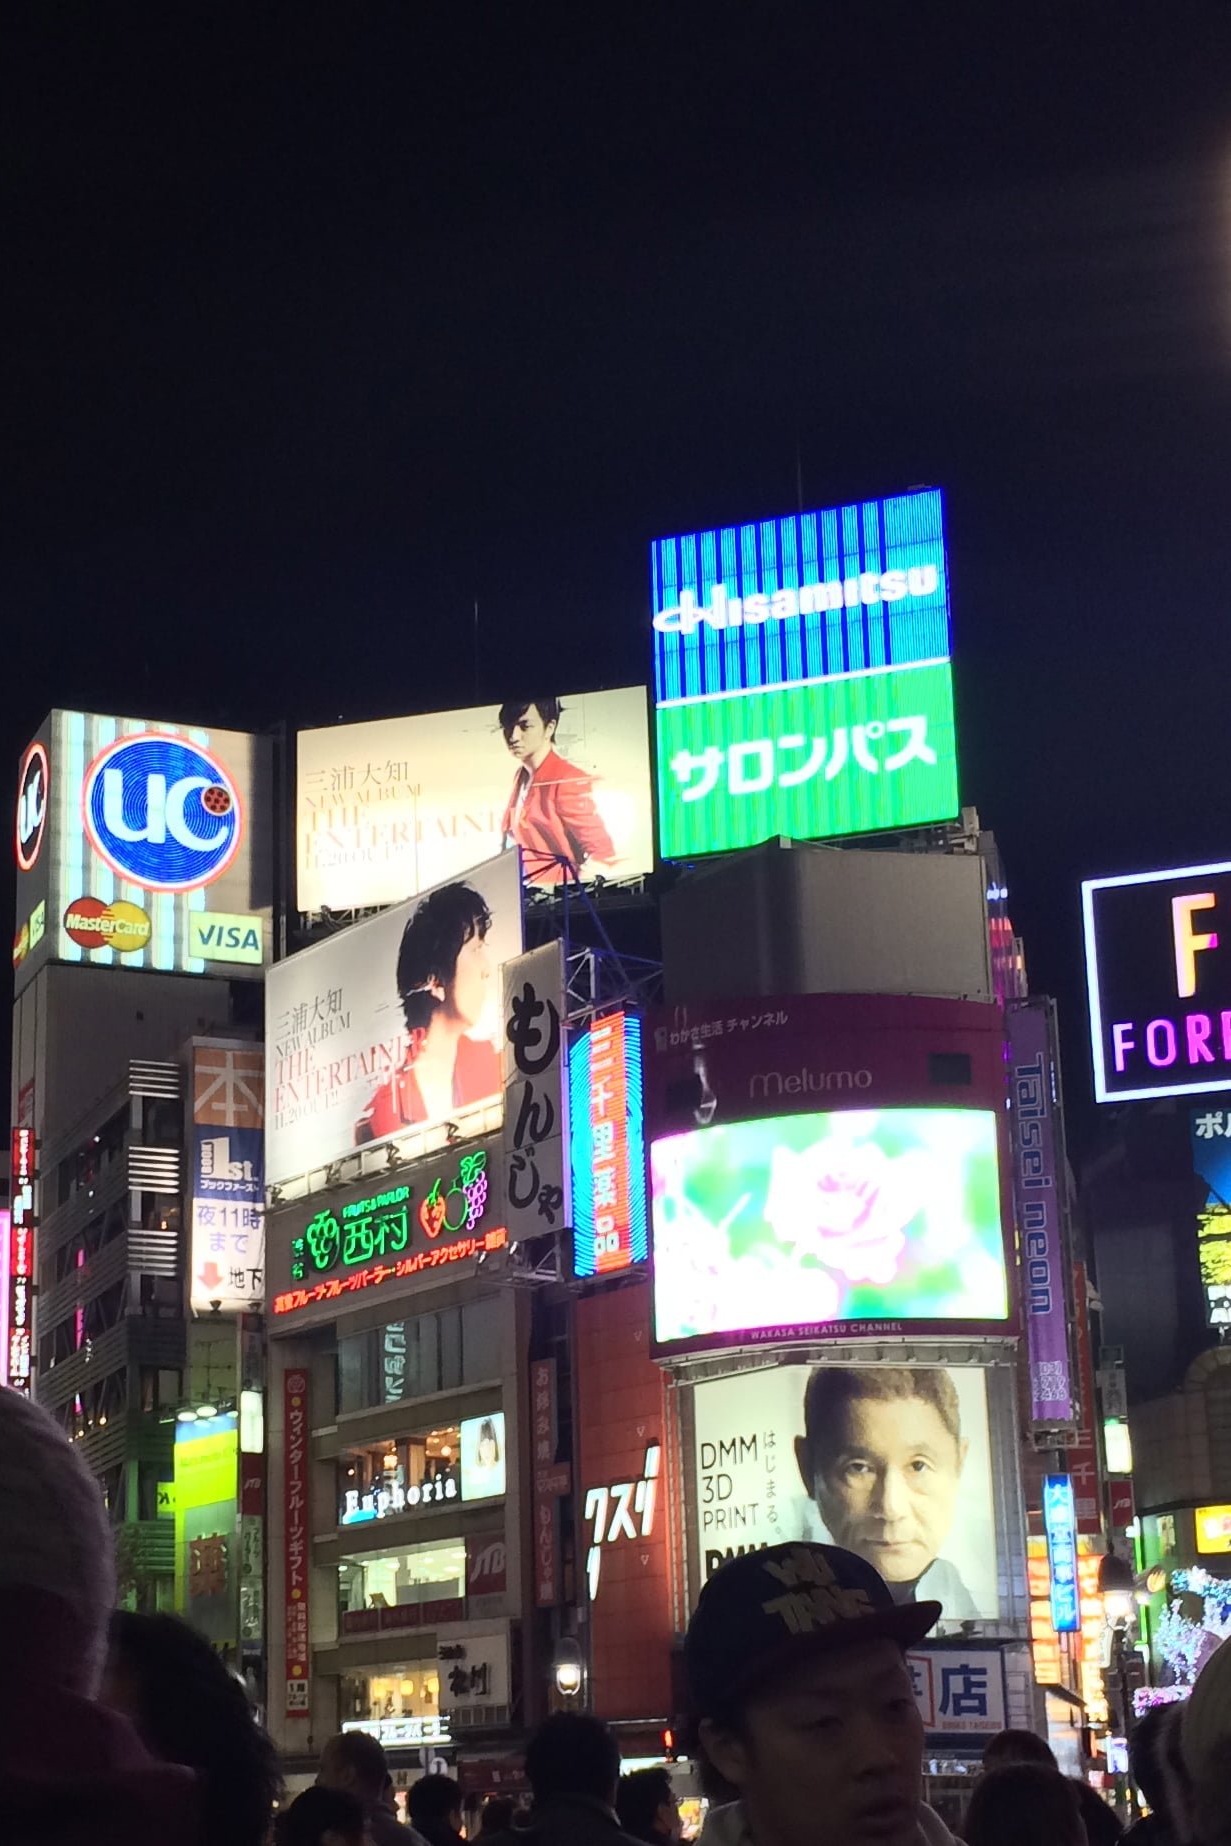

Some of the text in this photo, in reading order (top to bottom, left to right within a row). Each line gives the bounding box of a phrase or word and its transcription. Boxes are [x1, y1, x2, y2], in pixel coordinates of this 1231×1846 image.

[305, 760, 409, 793] 三浦大知
[670, 714, 938, 803] サロンパス
[66, 913, 150, 936] MasterCard
[198, 924, 260, 951] VISA
[275, 988, 343, 1041] 三浦大知
[669, 1010, 789, 1046] わかさ生活 チャンネル
[275, 1012, 351, 1058] NEW ALBUM
[275, 1047, 316, 1085] THE
[194, 1052, 266, 1127] 本
[506, 982, 563, 1225] もんじゃ
[200, 1180, 259, 1192] ブックファースト
[1016, 1052, 1053, 1315] Taisei neon
[197, 1205, 261, 1230] 夜11時
[343, 1206, 409, 1266] 西村
[209, 1232, 249, 1254] まで
[229, 1266, 263, 1291] 地下
[751, 1321, 903, 1340] WAKASA SEIKATSU CHANNEL
[701, 1433, 758, 1470] DMM
[345, 1474, 458, 1519] Euphoria
[702, 1473, 733, 1504] 3D
[703, 1503, 759, 1533] PRINT
[470, 1541, 505, 1582] JTB
[938, 1663, 988, 1717] 店
